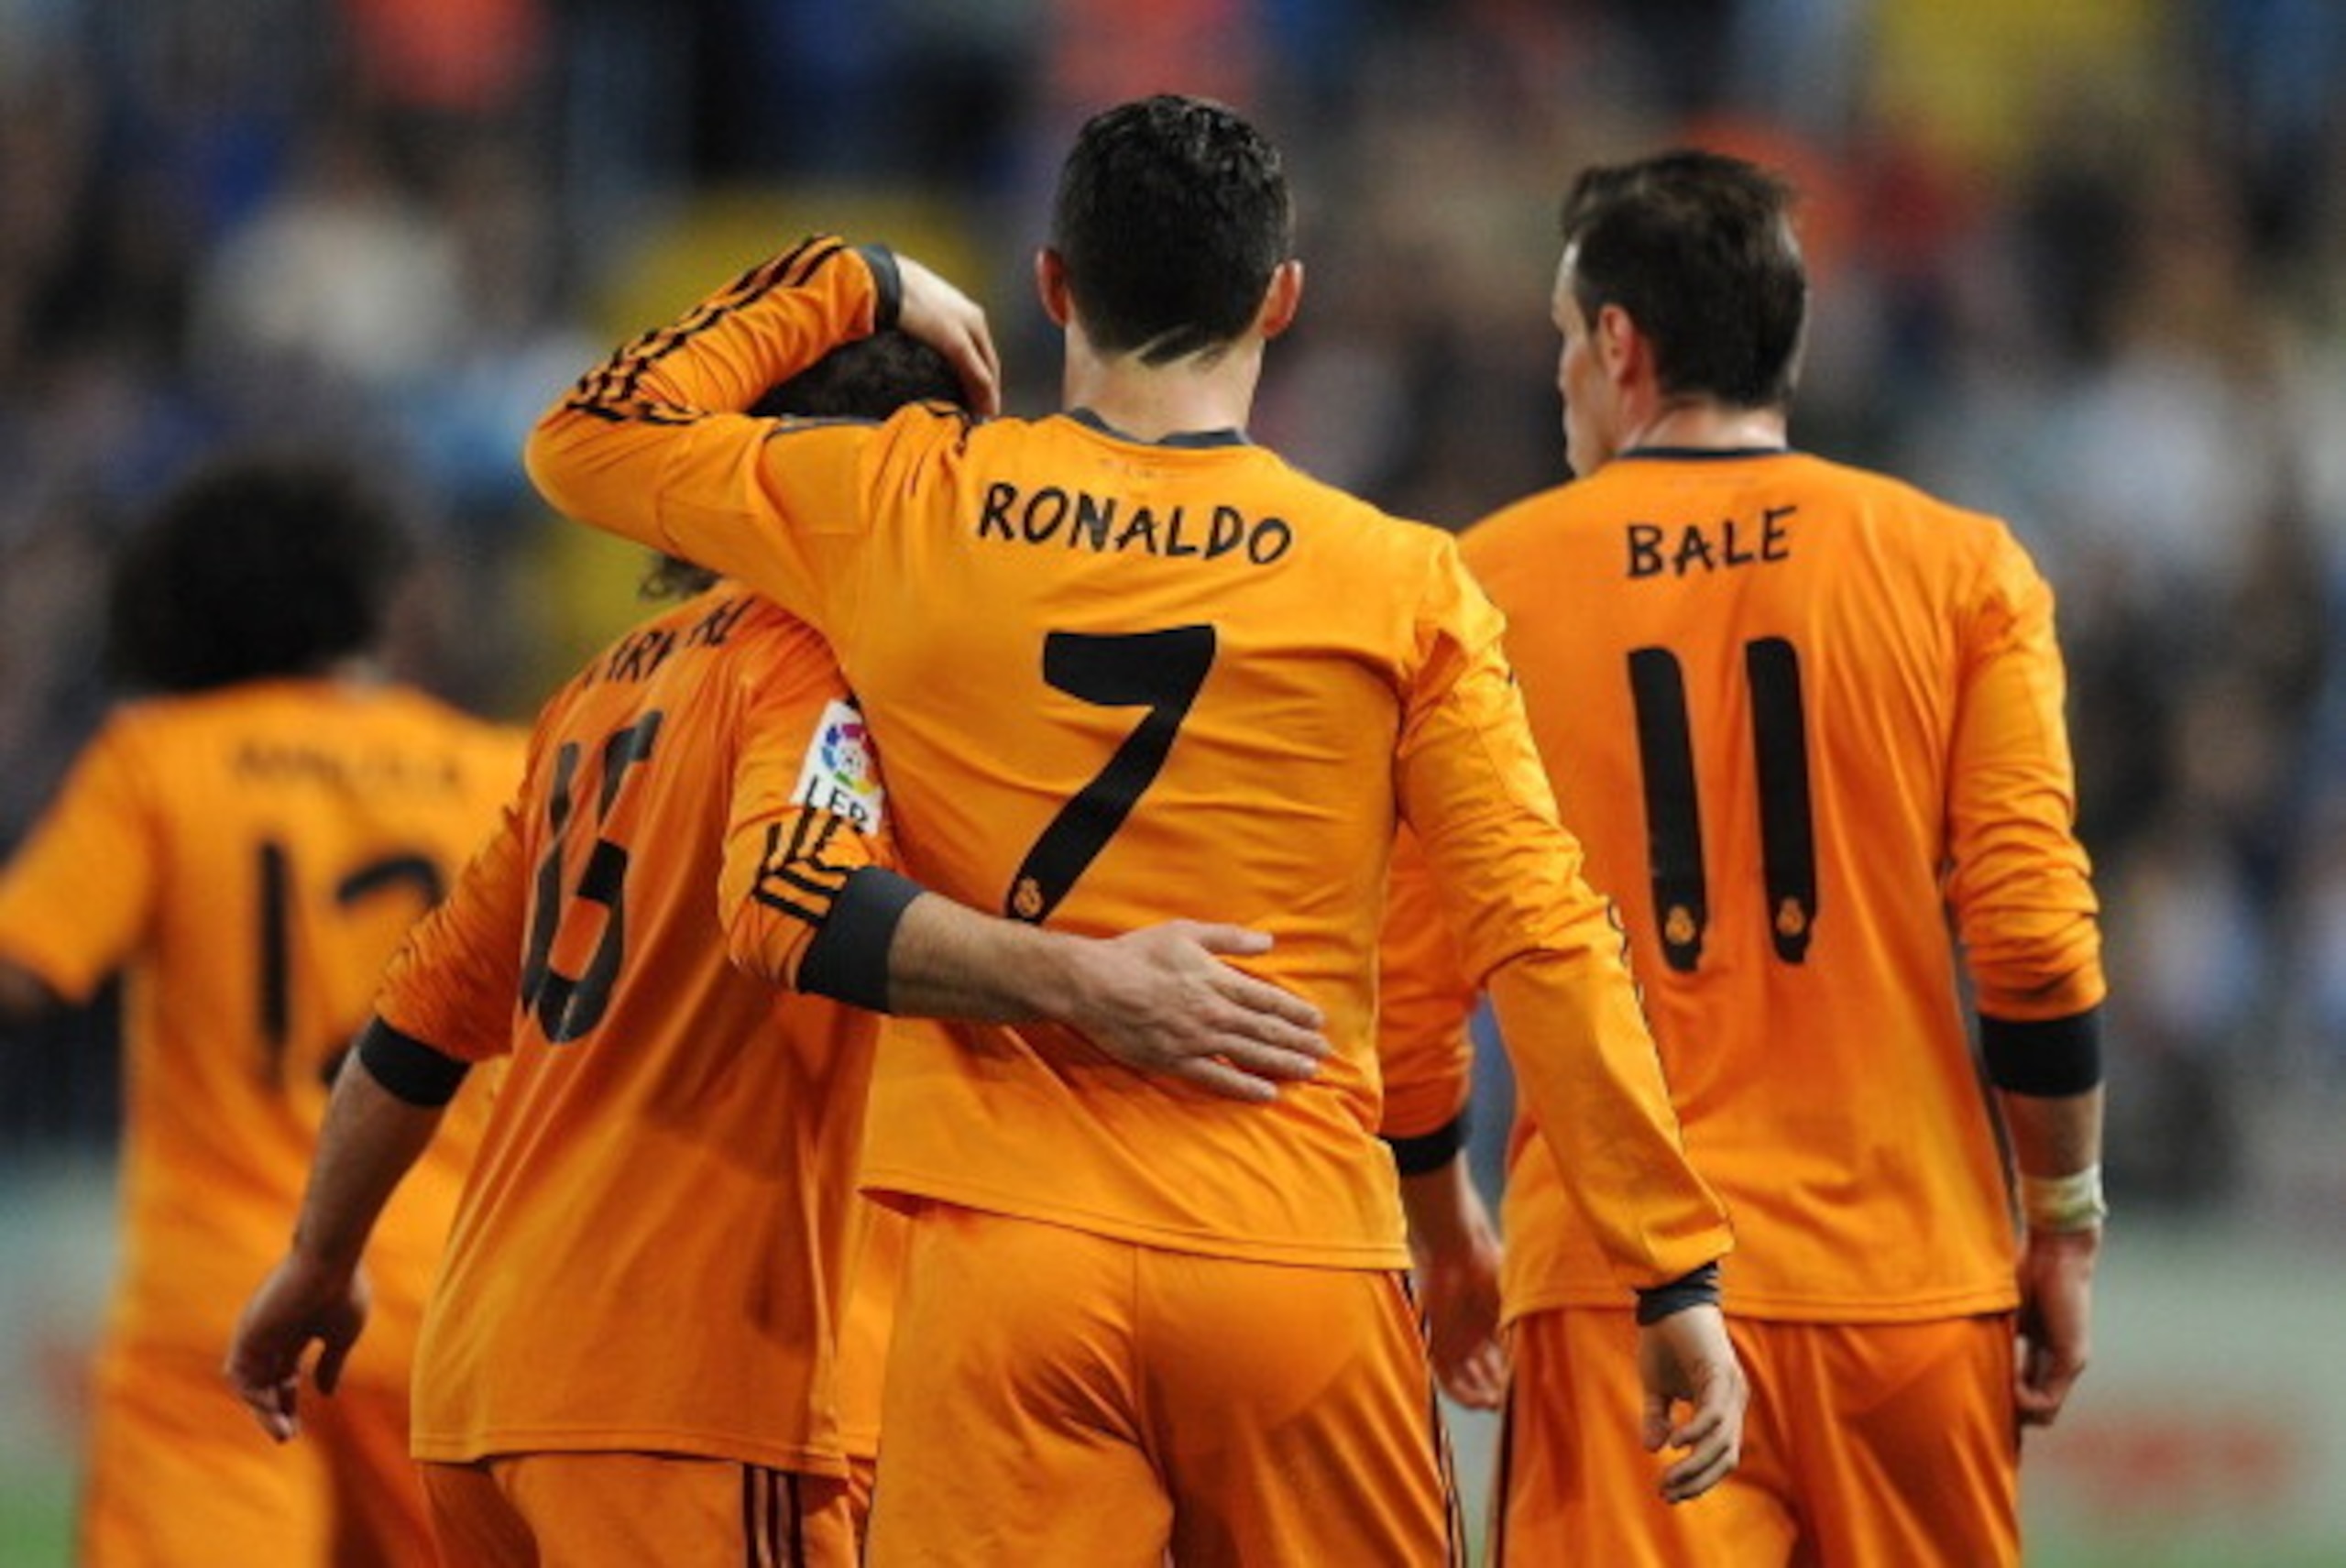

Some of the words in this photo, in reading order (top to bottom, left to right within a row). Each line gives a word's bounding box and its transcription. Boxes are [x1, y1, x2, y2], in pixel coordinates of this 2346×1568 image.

[978, 482, 1292, 565] RONALDO
[1627, 505, 1798, 578] BALE
[521, 709, 663, 1044] 15
[1004, 623, 1217, 926] 7
[1627, 635, 1817, 972] 11
